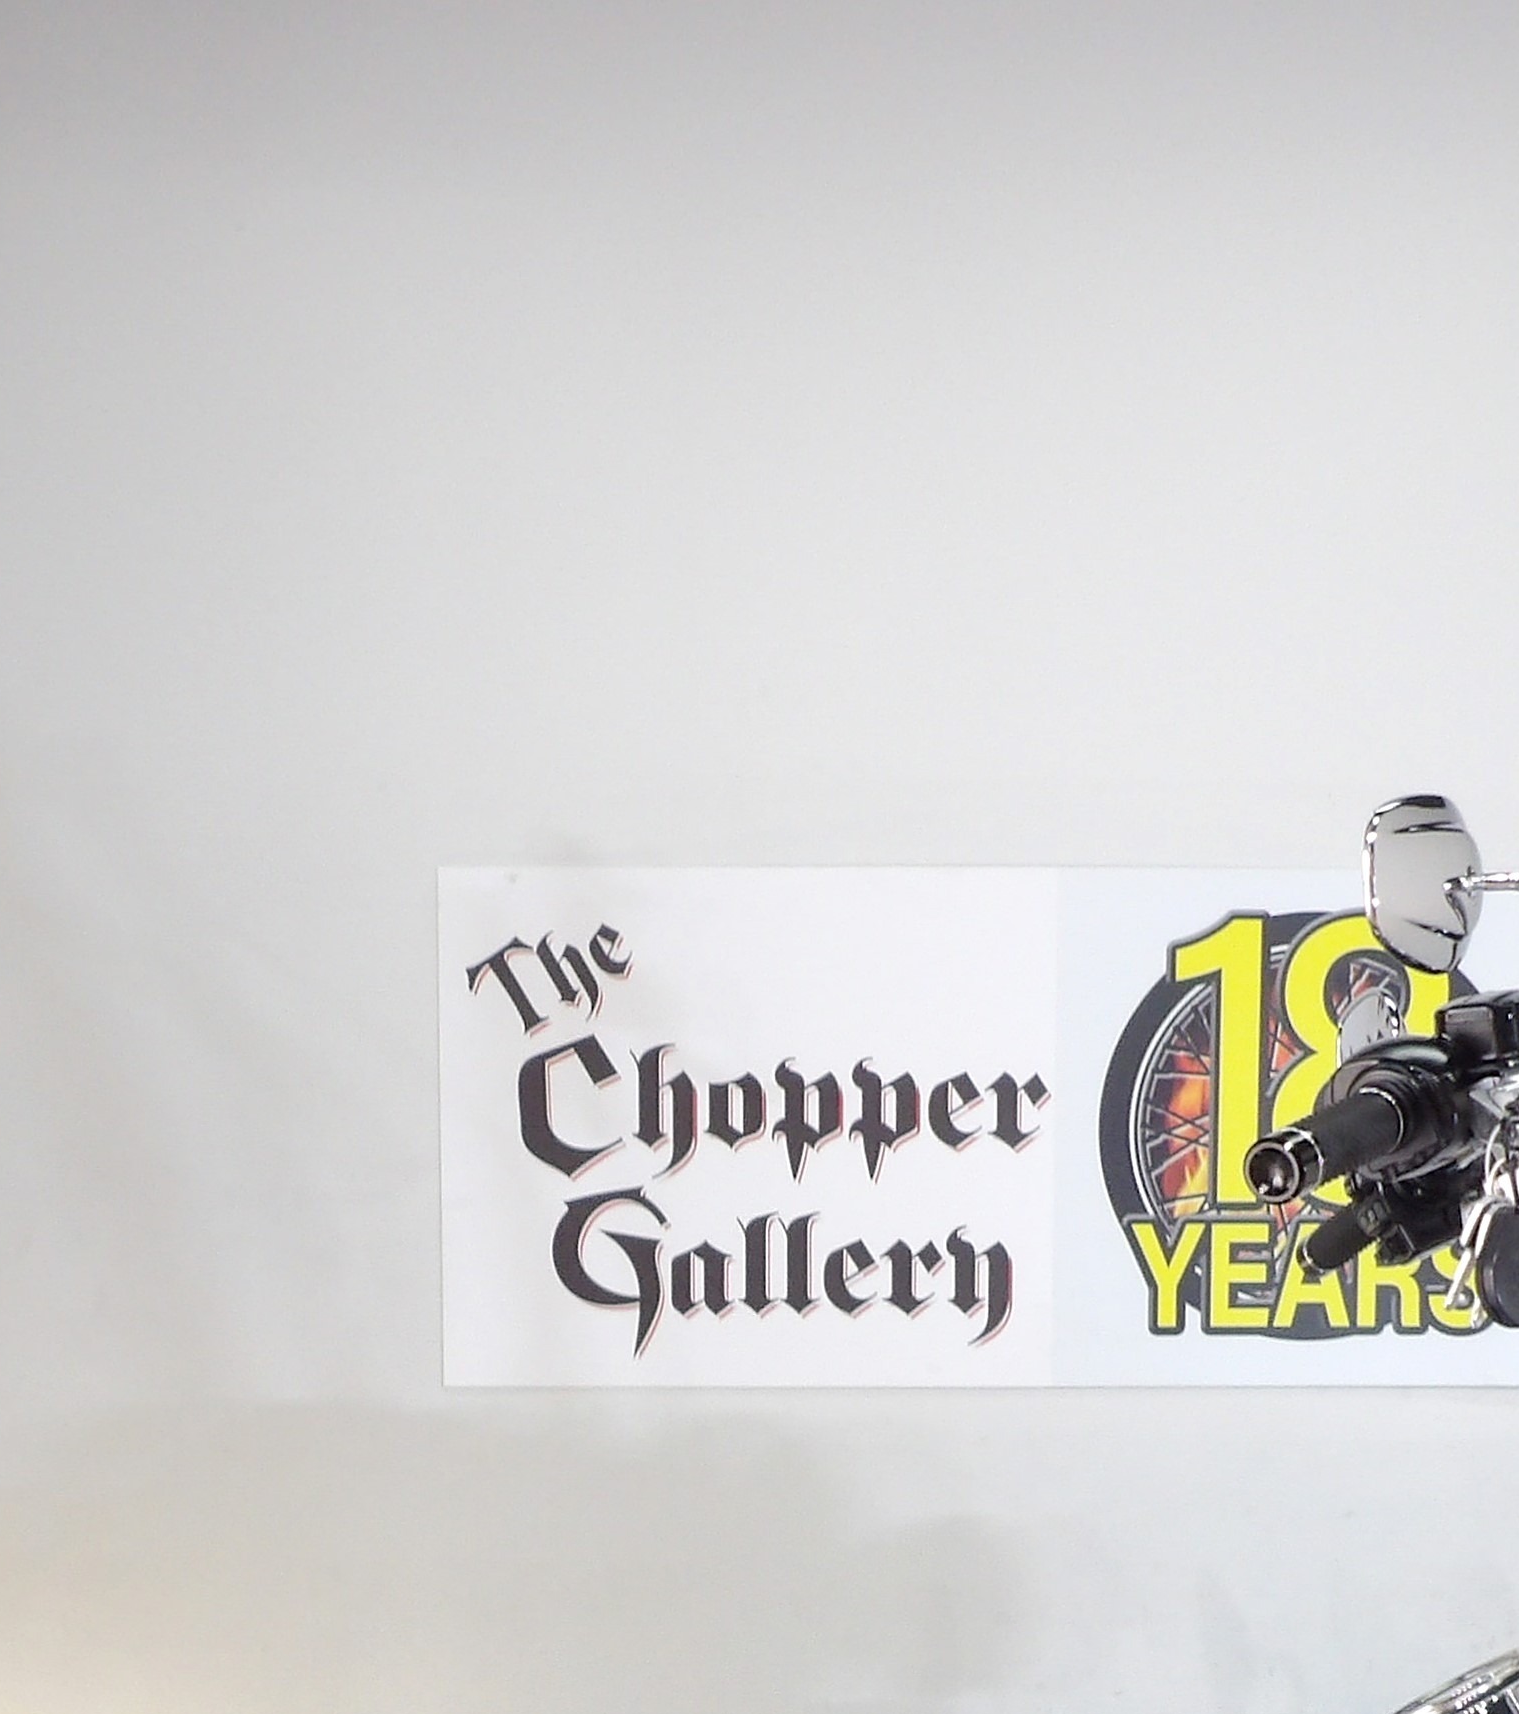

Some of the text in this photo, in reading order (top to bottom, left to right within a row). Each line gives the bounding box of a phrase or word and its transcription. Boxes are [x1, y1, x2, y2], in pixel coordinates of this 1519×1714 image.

[466, 923, 632, 1037] The
[518, 1034, 1051, 1183] Chopper
[552, 1187, 1013, 1360] Gallery
